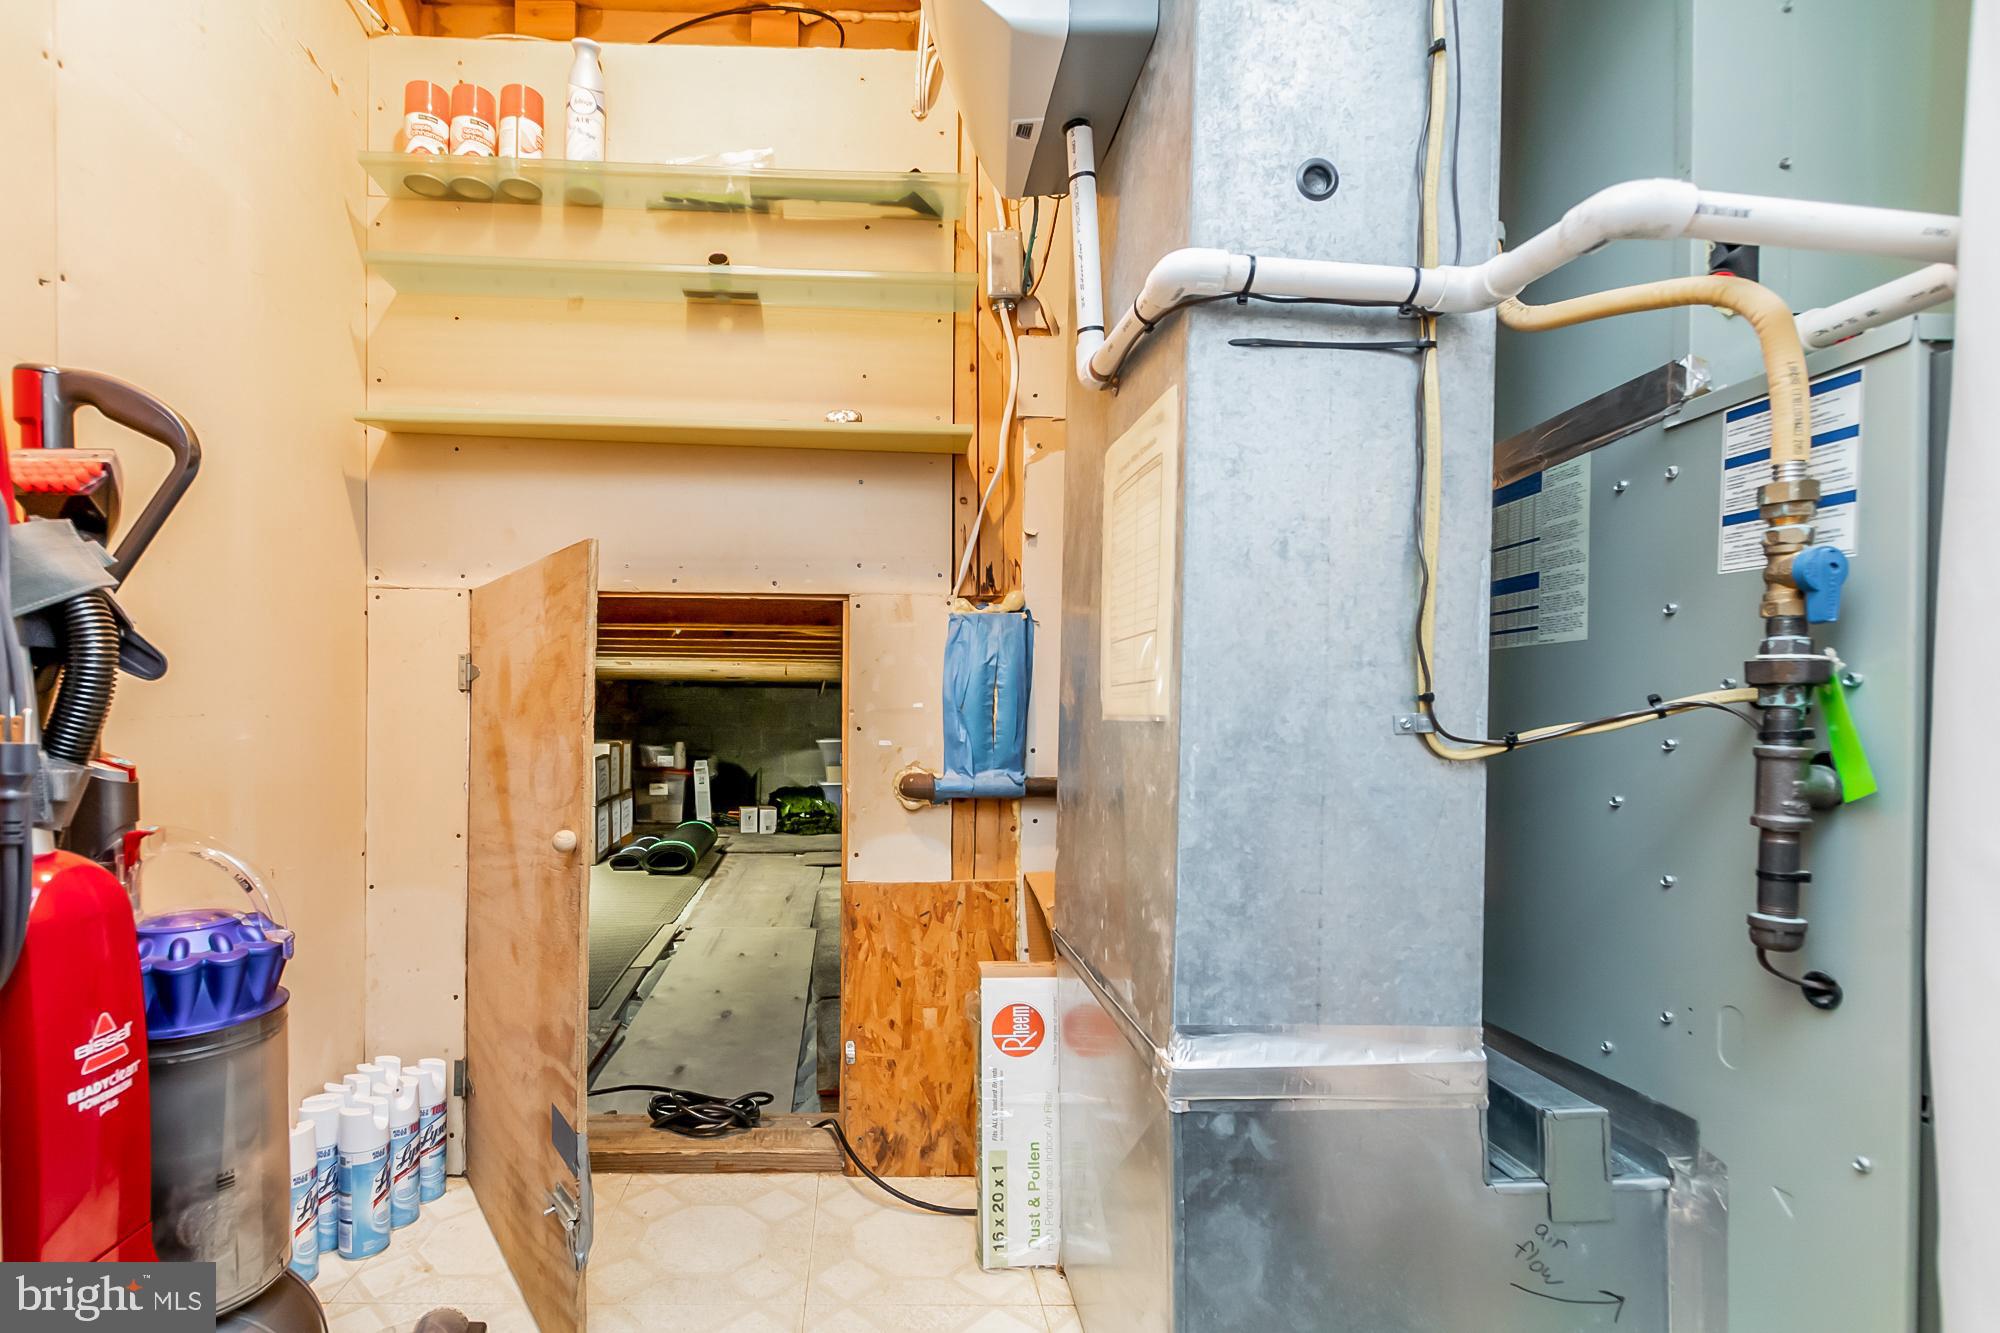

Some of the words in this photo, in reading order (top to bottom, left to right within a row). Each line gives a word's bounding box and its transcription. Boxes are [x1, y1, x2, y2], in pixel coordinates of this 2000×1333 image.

[993, 1005, 1038, 1051] Rheem
[1045, 1116, 1053, 1128] Air
[1028, 1142, 1040, 1191] Pollen
[995, 1179, 1004, 1187] x
[992, 1193, 1004, 1212] 20
[1028, 1197, 1040, 1208] &
[995, 1219, 1004, 1227] x
[992, 1232, 1005, 1251] 16
[1535, 1224, 1568, 1249] air
[1515, 1240, 1564, 1285] flow
